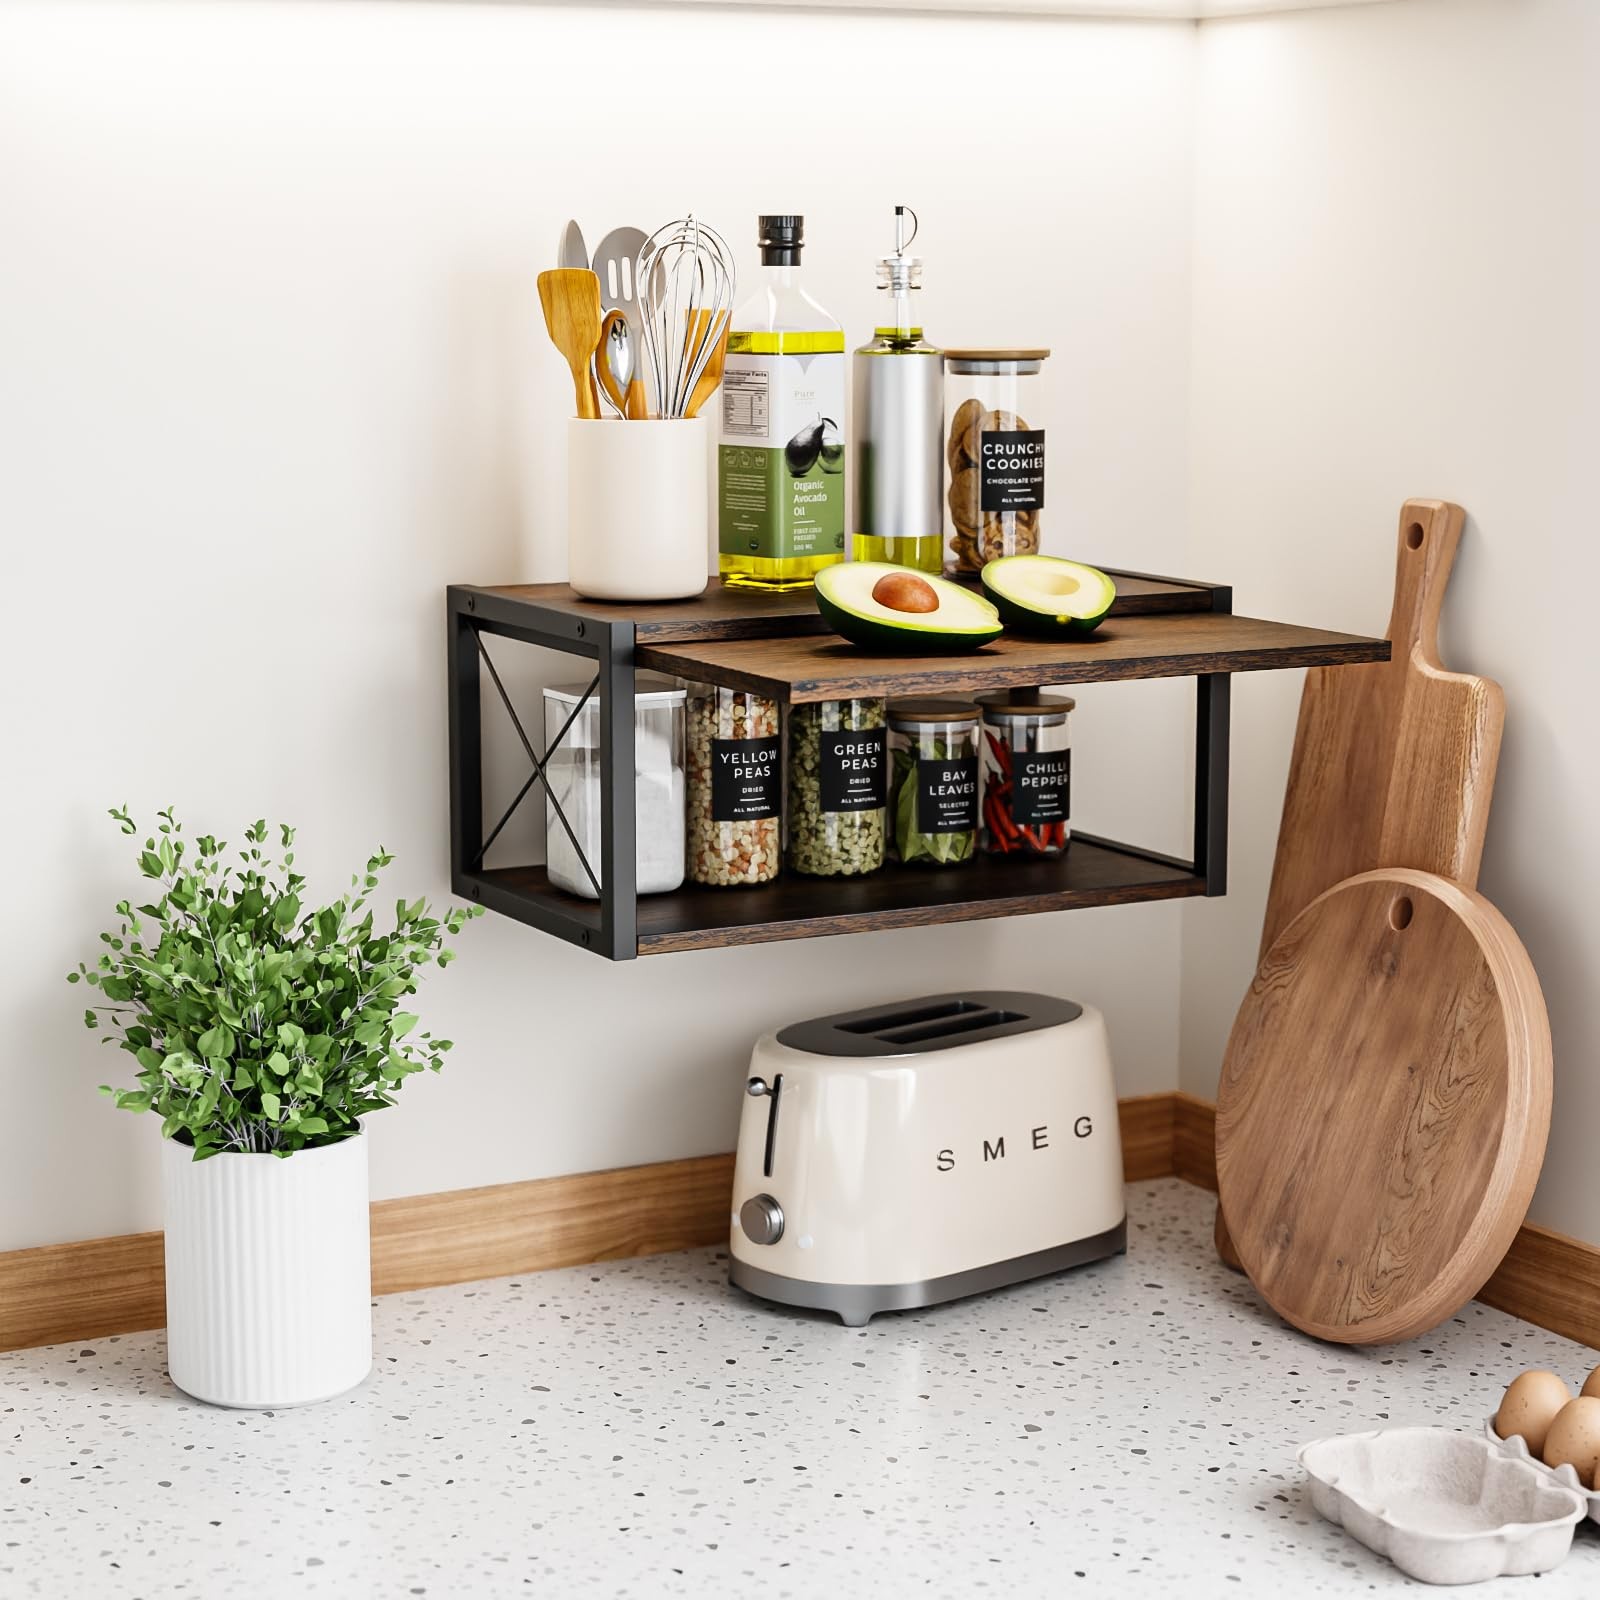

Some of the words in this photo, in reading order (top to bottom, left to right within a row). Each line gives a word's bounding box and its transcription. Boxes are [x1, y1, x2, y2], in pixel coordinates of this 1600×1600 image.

[986, 457, 1043, 470] COOKIES
[793, 480, 825, 492] Organic
[986, 477, 1029, 485] CHOCOLATE
[793, 493, 828, 504] Avocado
[793, 506, 806, 516] Oil
[834, 742, 881, 756] GREEN
[720, 749, 777, 764] YELLOW
[841, 757, 878, 770] PEAS
[734, 765, 771, 779] PEAS
[942, 770, 968, 782] BAY
[849, 777, 871, 785] DRIED
[742, 786, 764, 794] DRIED
[929, 782, 975, 796] LEAVES
[746, 804, 771, 812] NATURAL
[938, 801, 970, 809] SELECTED
[936, 1116, 1093, 1172] SMEG
